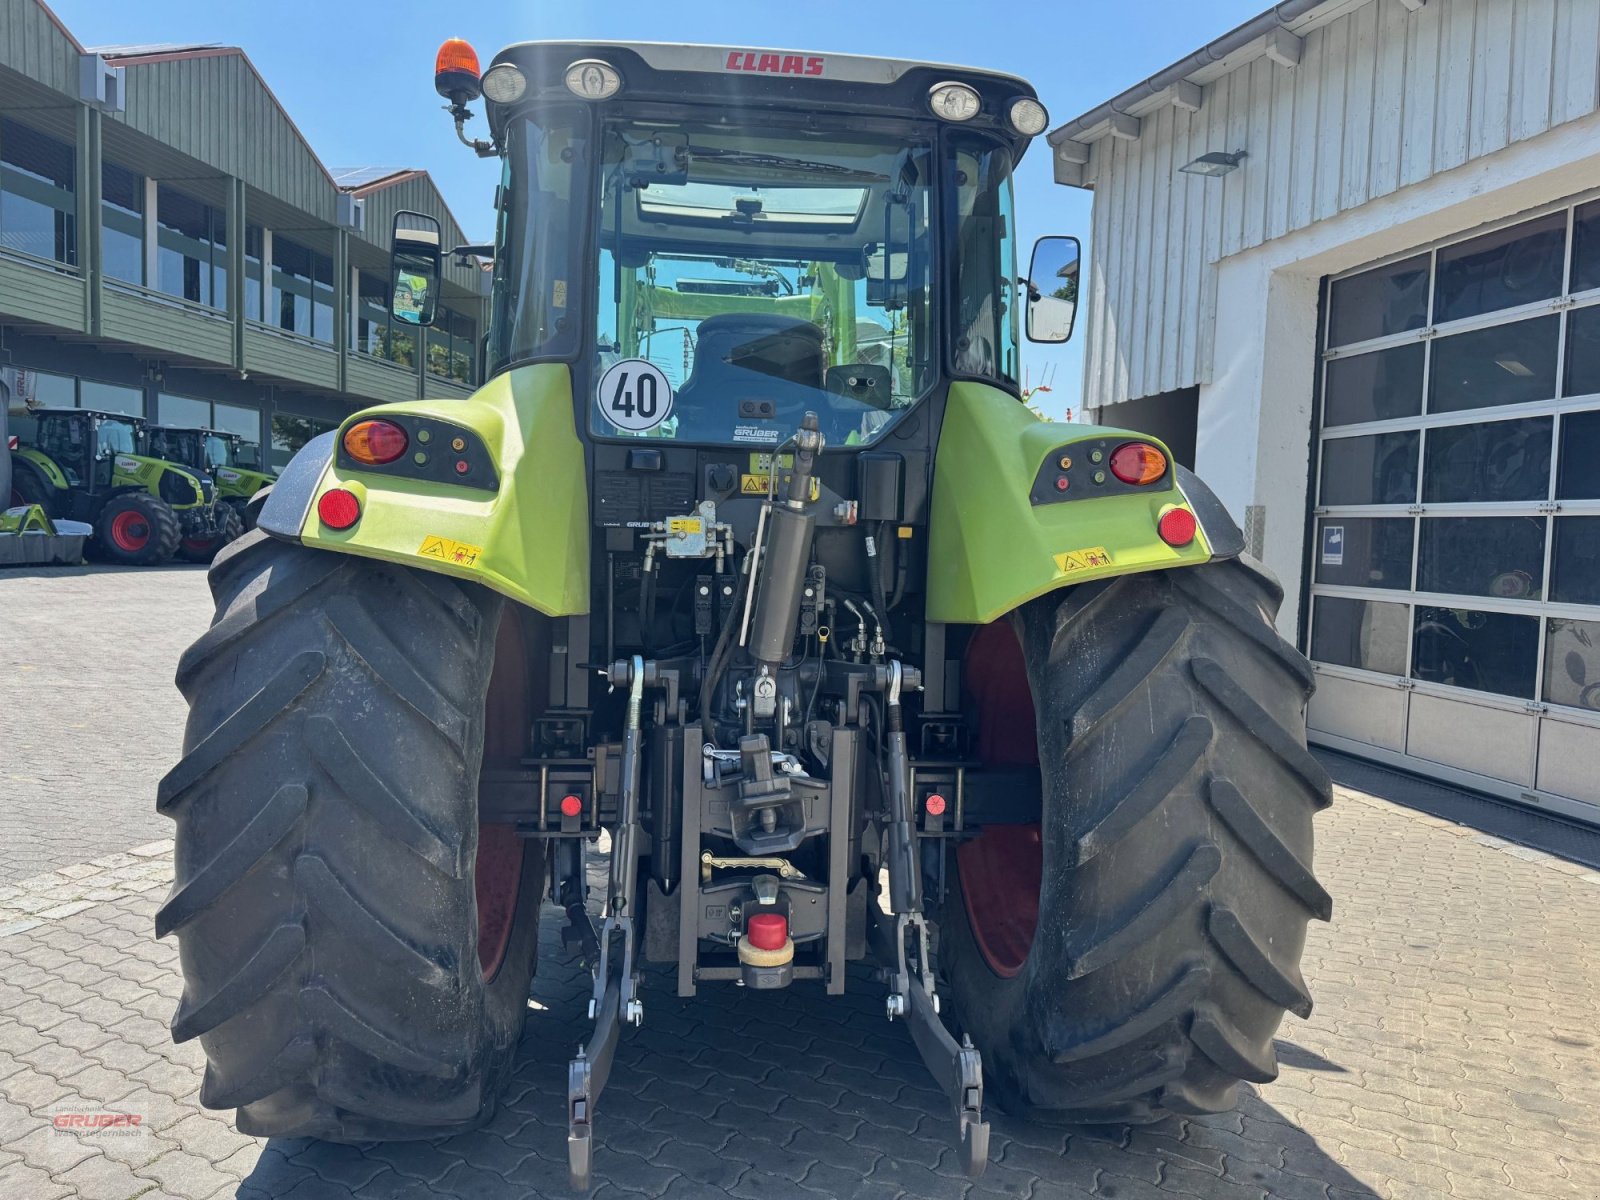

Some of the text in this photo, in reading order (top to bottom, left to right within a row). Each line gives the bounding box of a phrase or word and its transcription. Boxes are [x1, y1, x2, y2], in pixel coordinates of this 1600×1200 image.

[726, 51, 824, 75] CLAAS
[612, 372, 656, 418] 40
[734, 429, 779, 438] GRUBER
